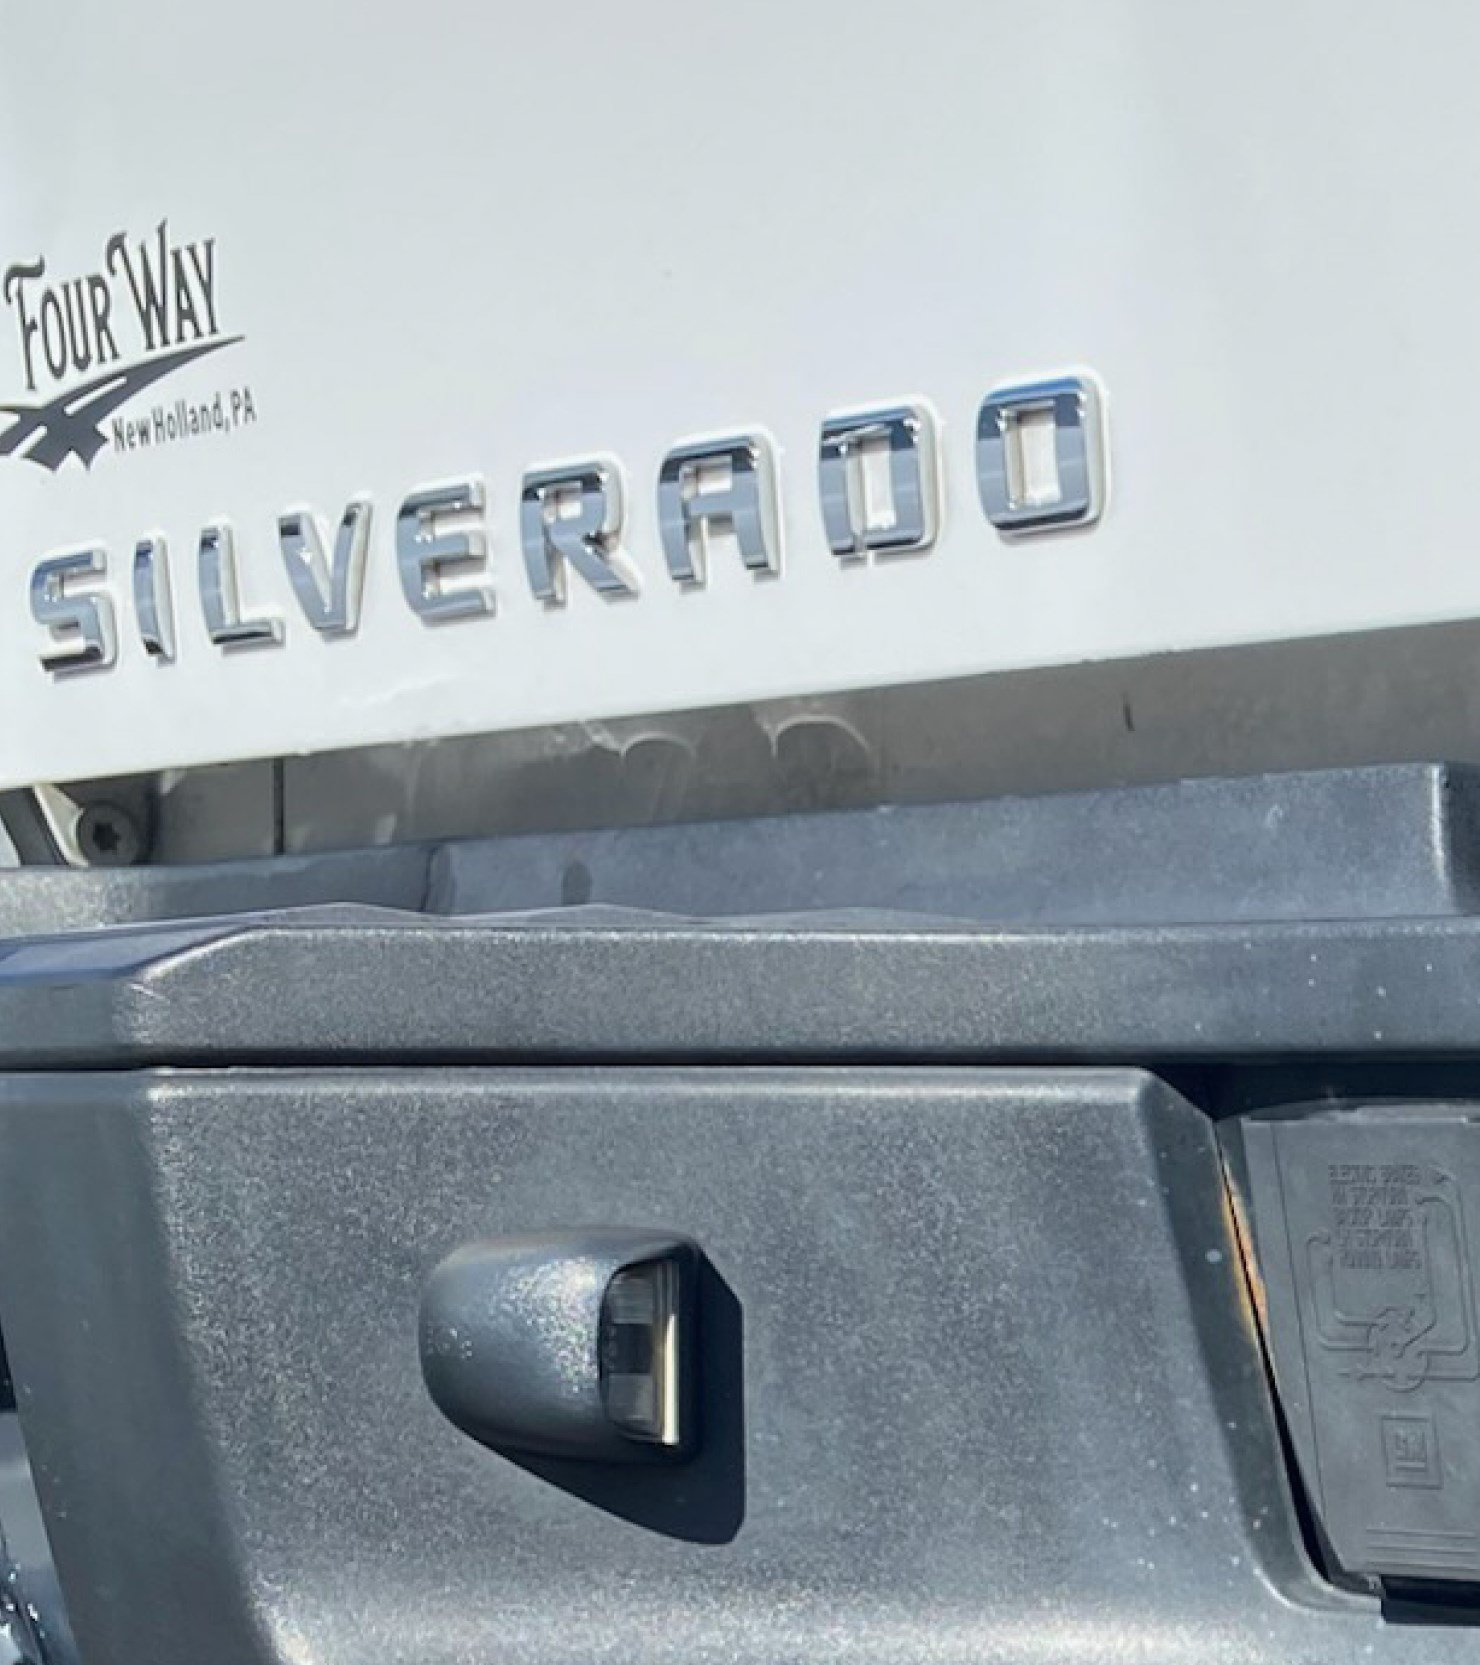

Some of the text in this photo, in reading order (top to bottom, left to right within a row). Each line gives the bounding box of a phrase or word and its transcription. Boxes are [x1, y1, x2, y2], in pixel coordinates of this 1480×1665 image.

[3, 217, 218, 391] FOUR WAY
[112, 415, 152, 452] New
[230, 386, 256, 427] PA
[28, 370, 1111, 675] SILVERADO
